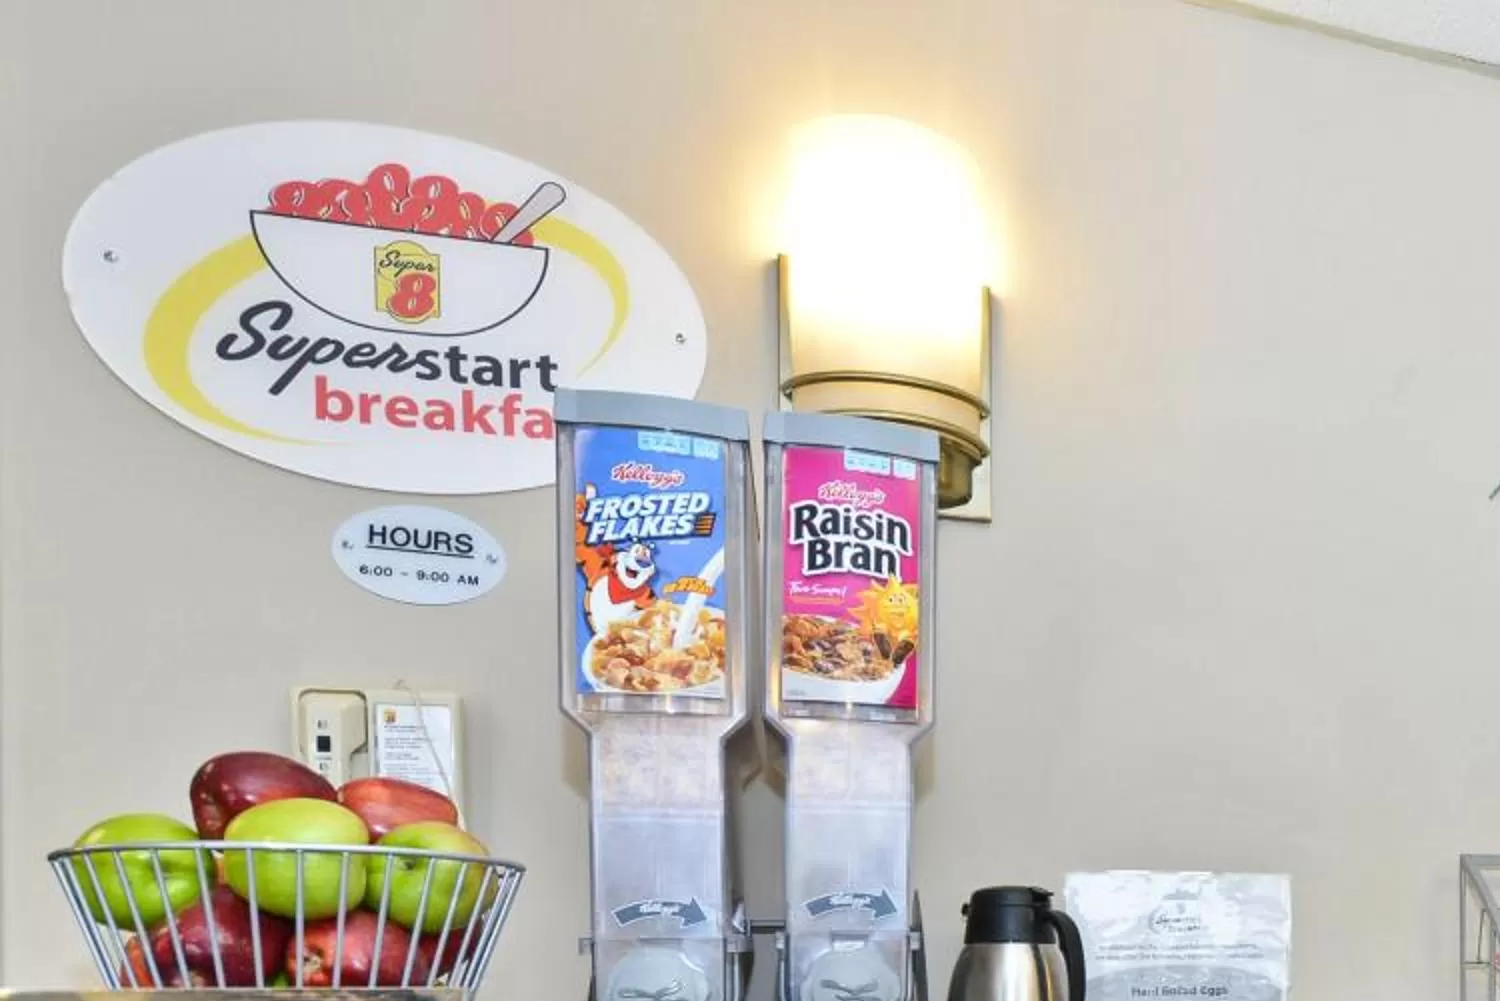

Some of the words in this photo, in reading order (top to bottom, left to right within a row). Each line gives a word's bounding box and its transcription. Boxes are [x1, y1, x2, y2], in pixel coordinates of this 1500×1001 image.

[379, 250, 434, 278] Super
[388, 271, 437, 318] 8
[216, 300, 559, 396] Superstart
[314, 375, 555, 440] breakfa
[586, 491, 710, 523] FROSTED
[368, 523, 475, 554] HOURS
[587, 513, 696, 543] FLAKES
[794, 503, 909, 552] Raisin
[359, 563, 393, 577] 6:00
[416, 569, 450, 583] 9:00
[457, 575, 480, 586] AM
[807, 538, 898, 576] Bran
